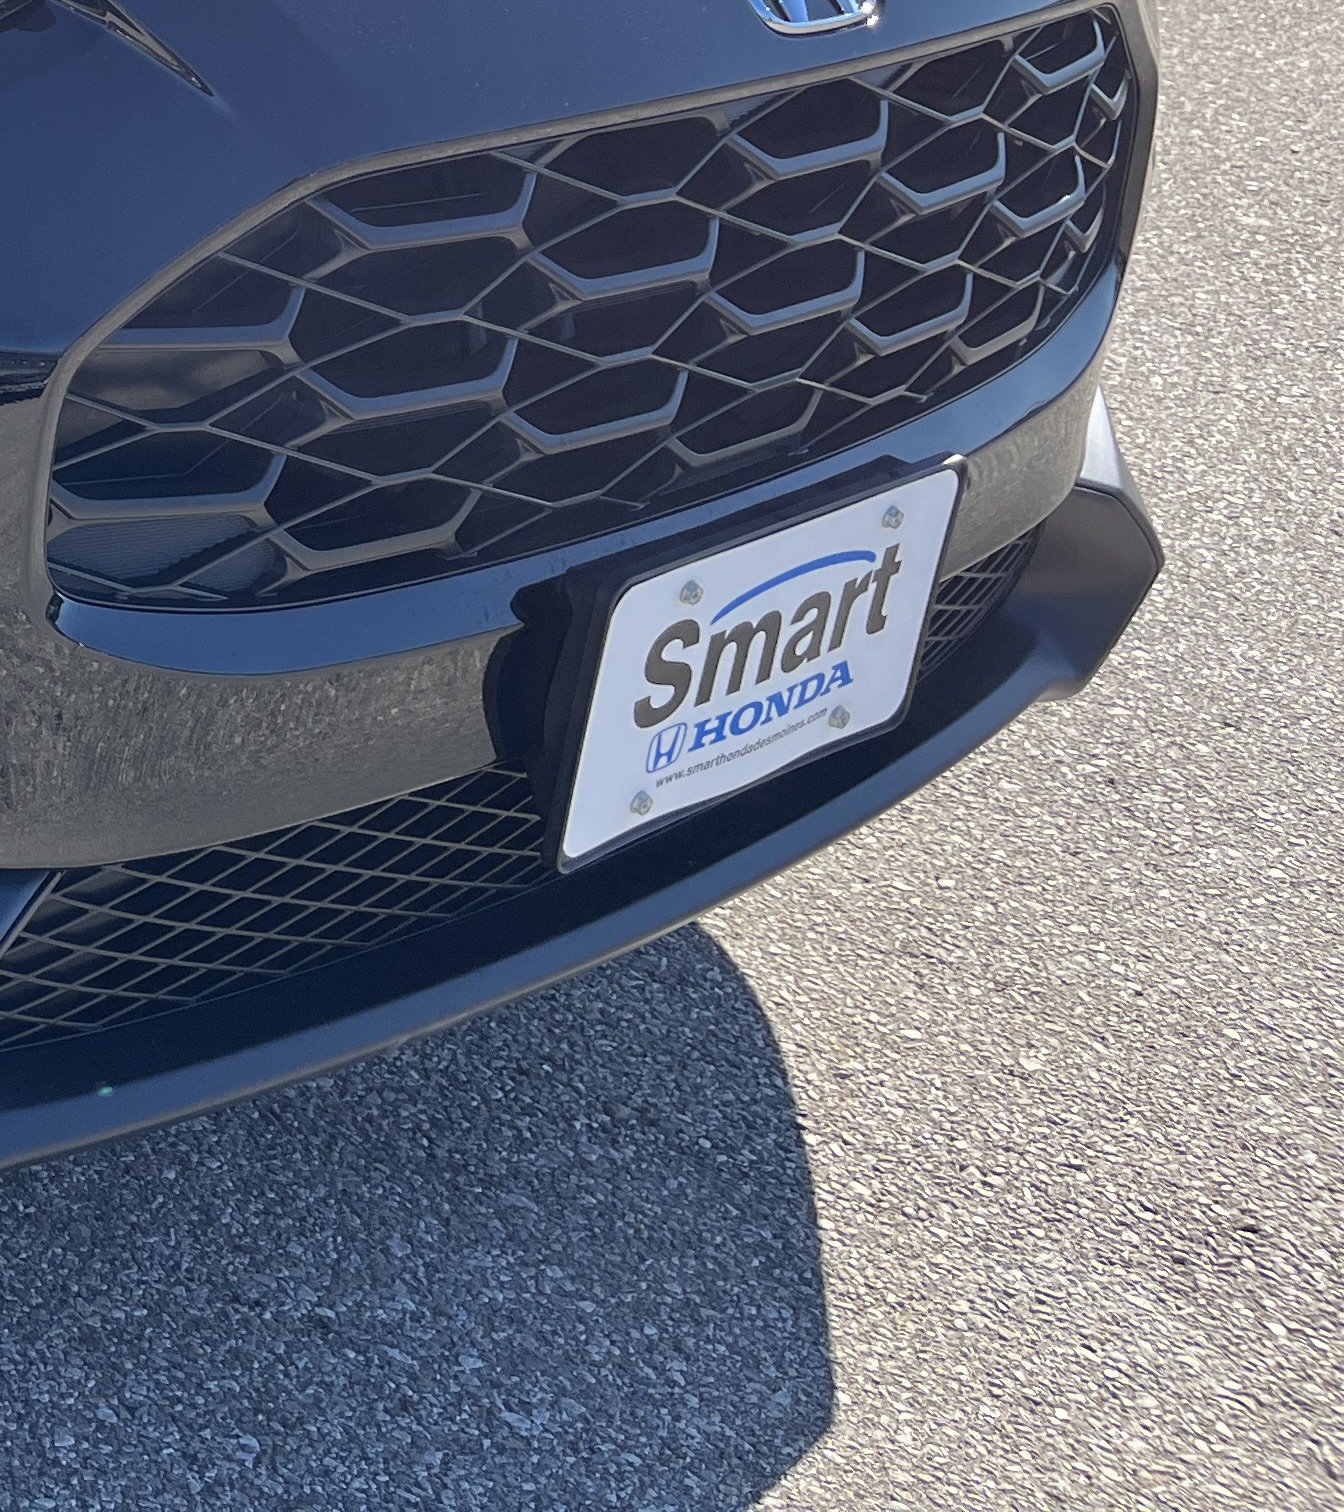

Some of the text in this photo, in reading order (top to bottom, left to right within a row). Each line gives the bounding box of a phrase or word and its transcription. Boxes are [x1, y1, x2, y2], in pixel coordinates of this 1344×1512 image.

[634, 543, 902, 729] Smart
[656, 707, 828, 788] www.smarthondadesmoines.com
[688, 660, 853, 753] HONDA
